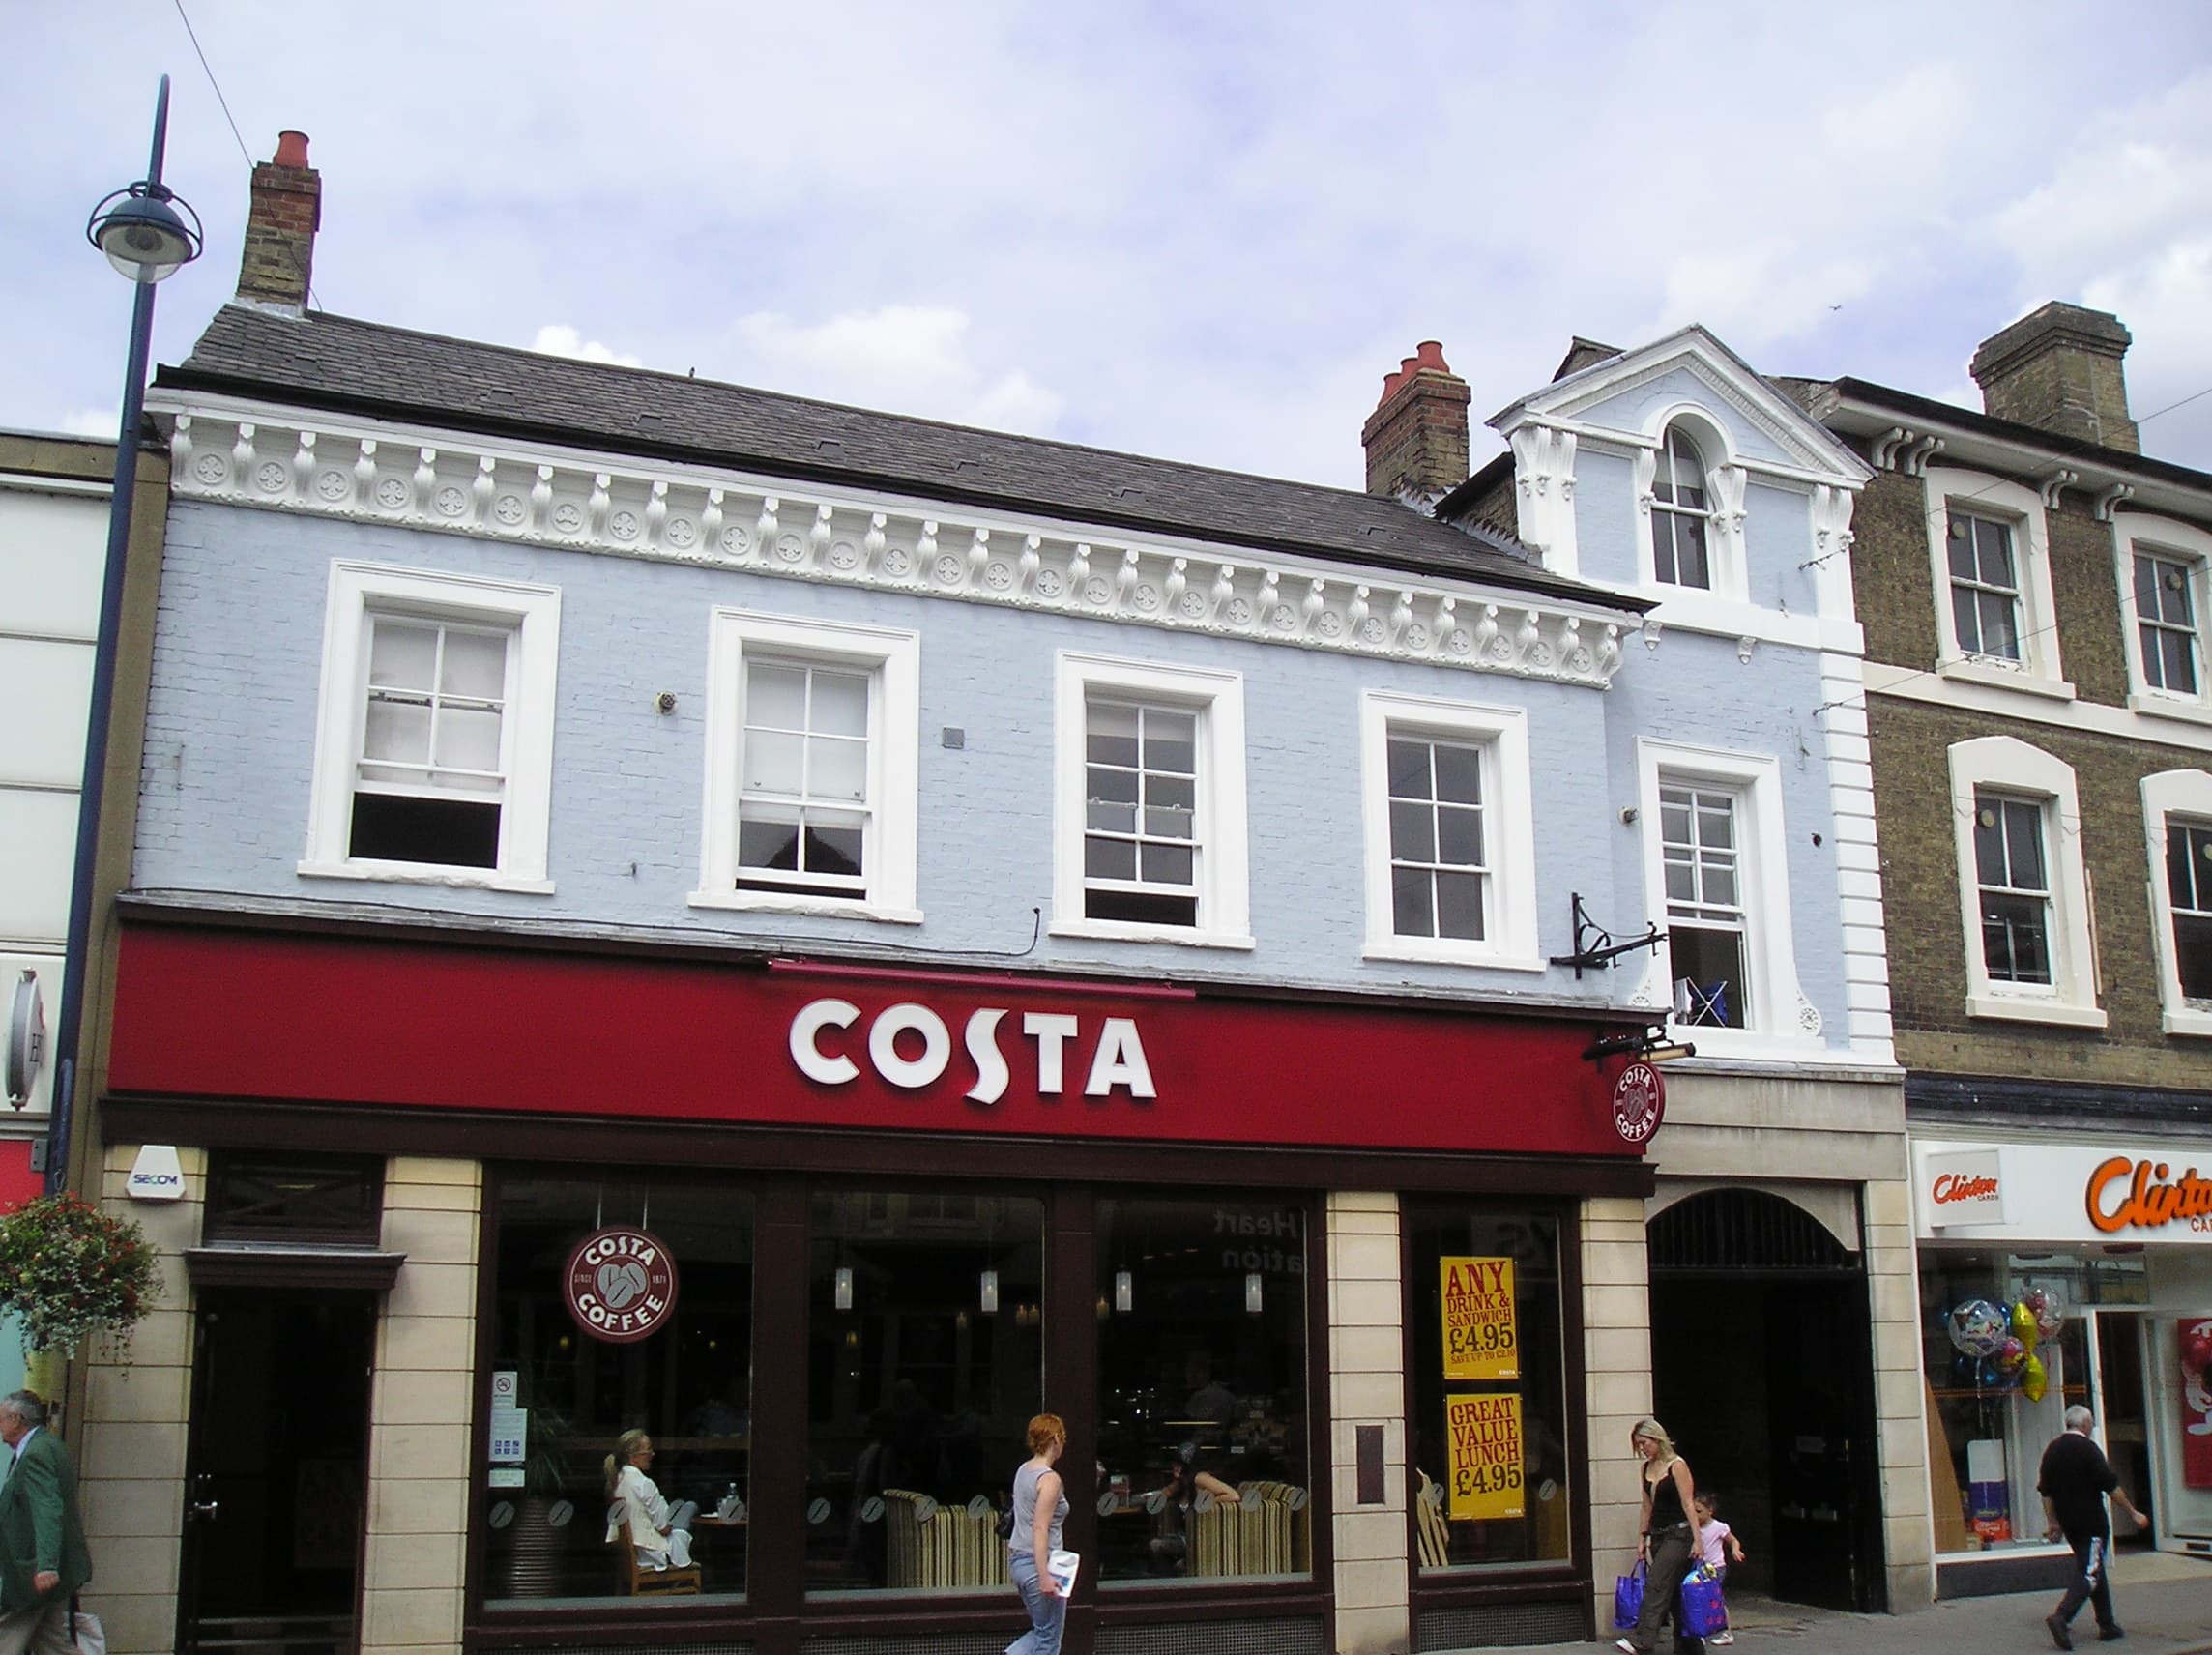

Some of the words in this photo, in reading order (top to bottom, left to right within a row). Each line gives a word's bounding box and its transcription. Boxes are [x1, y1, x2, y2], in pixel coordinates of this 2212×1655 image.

[789, 998, 1157, 1105] COSTA
[1619, 1068, 1651, 1092] COSTA
[1617, 1109, 1655, 1138] COFFEE
[133, 1174, 178, 1185] SECOM
[1933, 1174, 1997, 1205] Clinton
[2191, 1217, 2212, 1232] CA
[585, 1236, 655, 1266] COSTA
[1445, 1261, 1505, 1297] ANY
[578, 1293, 663, 1331] COFFEE
[1447, 1293, 1495, 1314] DRINK
[1499, 1292, 1510, 1308] &
[1448, 1308, 1512, 1327] SANDWICH
[1449, 1321, 1514, 1354] £4.95
[1450, 1353, 1470, 1364] SAVE
[1470, 1351, 1482, 1362] UP
[1484, 1350, 1495, 1361] TO
[1451, 1397, 1514, 1426] GREAT
[1452, 1418, 1518, 1447] VALUE
[1455, 1440, 1520, 1469] LUNCH
[1456, 1462, 1521, 1496] £4.95
